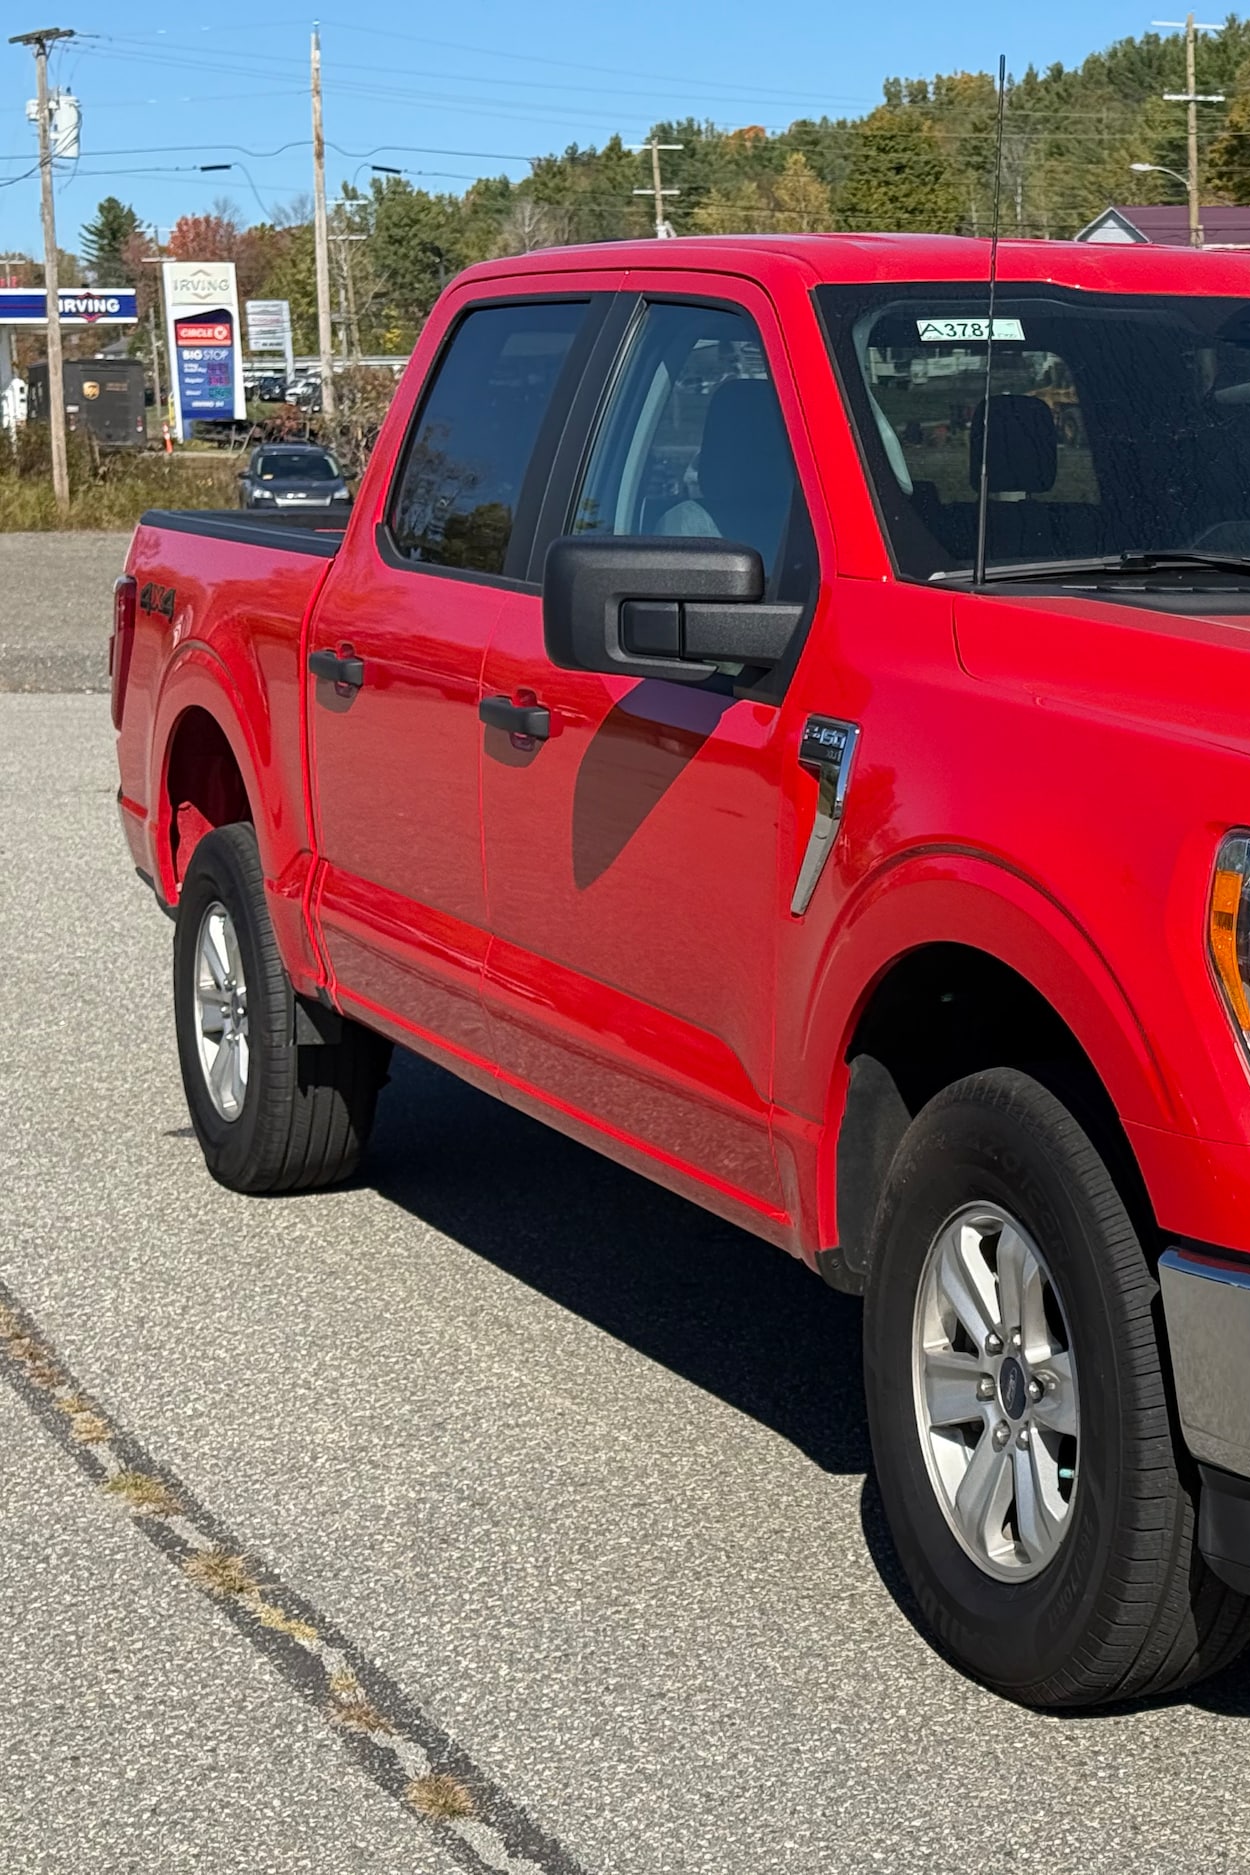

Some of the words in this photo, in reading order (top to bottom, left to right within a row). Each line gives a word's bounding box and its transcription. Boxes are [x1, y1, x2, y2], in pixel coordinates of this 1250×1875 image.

[174, 279, 230, 292] IRVING
[58, 298, 120, 314] IRVING
[180, 327, 214, 338] CIRCLE
[182, 349, 203, 361] BIG
[203, 349, 229, 361] STOP
